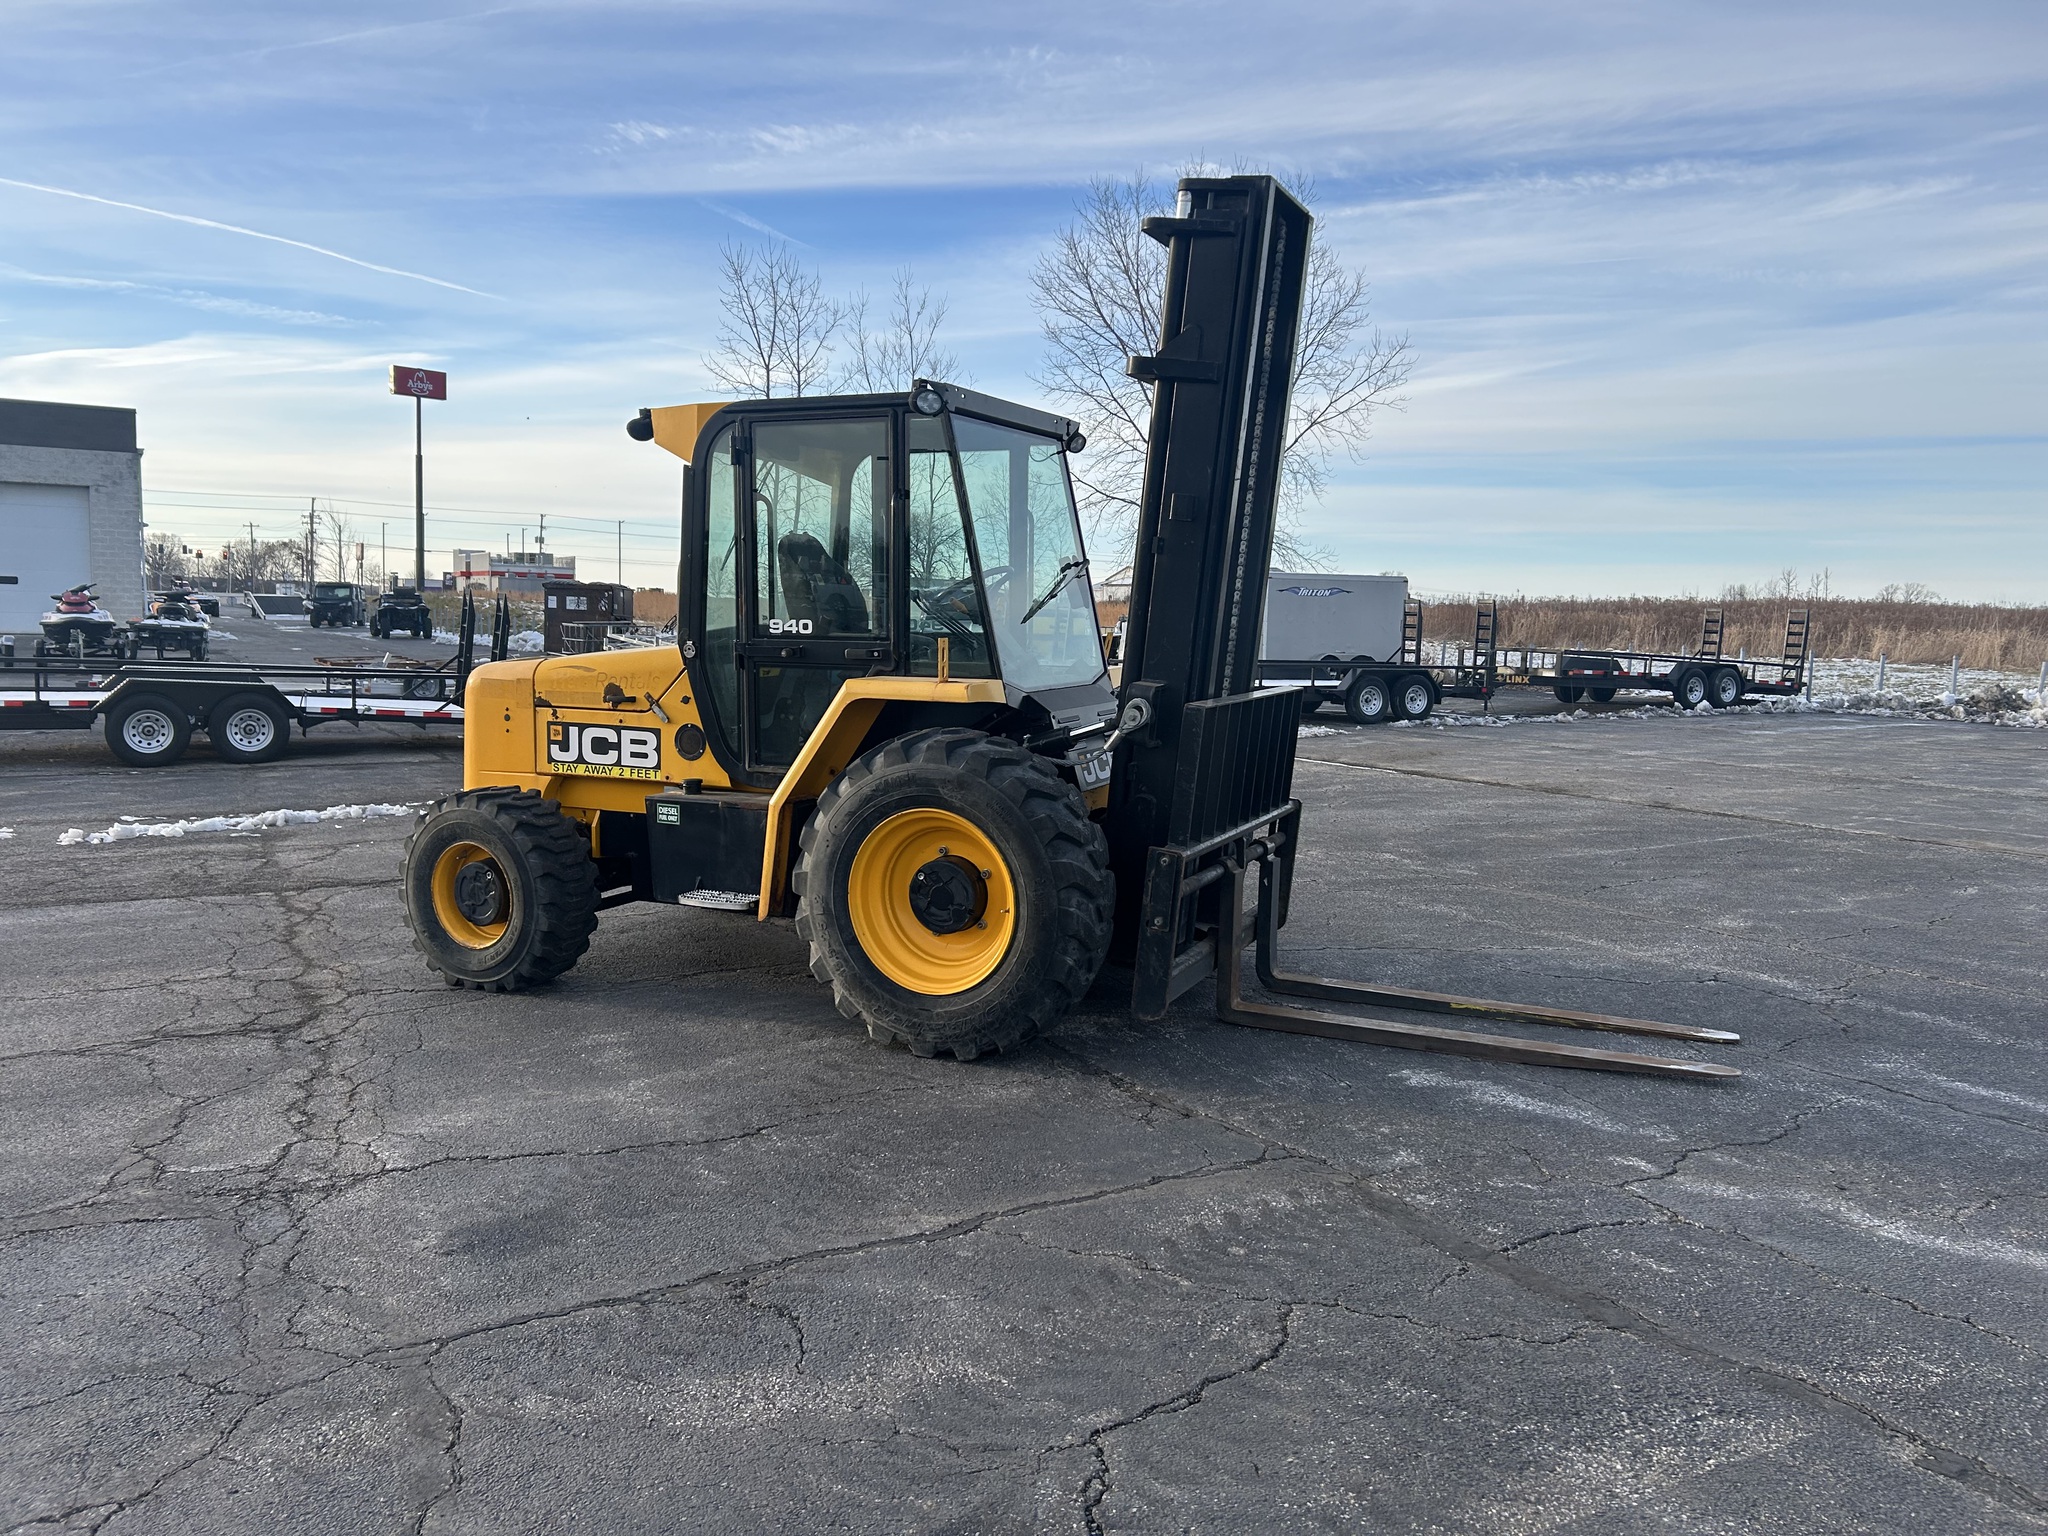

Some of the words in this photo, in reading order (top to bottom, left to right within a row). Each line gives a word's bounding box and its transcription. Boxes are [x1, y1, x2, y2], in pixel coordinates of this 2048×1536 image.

[407, 379, 433, 391] Arby's
[1297, 586, 1331, 597] TRITON
[769, 618, 813, 634] 940
[1506, 675, 1530, 684] LINX
[550, 725, 659, 768] JCB
[553, 763, 579, 774] STAY
[584, 765, 614, 777] AWAY
[618, 768, 625, 777] 2
[630, 768, 660, 780] FEET
[1083, 750, 1113, 783] JC
[658, 806, 678, 815] DIESEL
